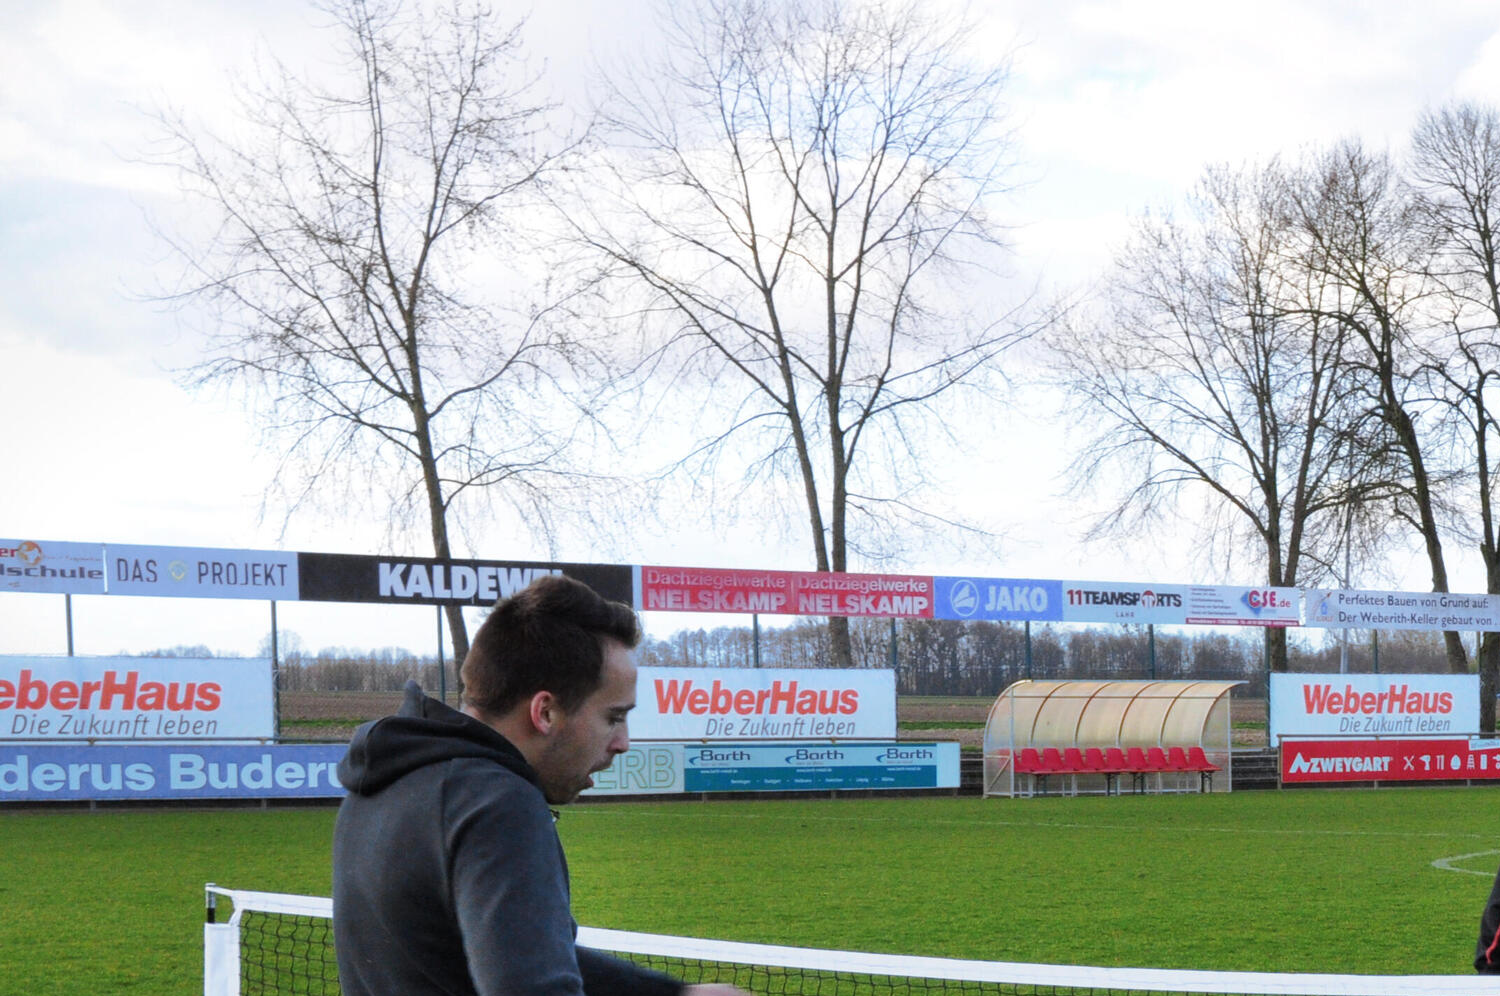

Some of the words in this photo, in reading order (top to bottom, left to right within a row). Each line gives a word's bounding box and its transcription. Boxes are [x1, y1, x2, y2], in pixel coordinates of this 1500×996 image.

[116, 558, 157, 583] DAS
[197, 561, 288, 586] PROJEKT
[378, 562, 564, 600] KALDEW
[647, 570, 786, 589] Dachziegelwerke
[798, 576, 928, 593] Dachziegelwerke
[648, 588, 787, 611] NELSKAMP
[799, 593, 929, 615] NELSKAMP
[985, 586, 1048, 612] JAKO
[1338, 594, 1384, 607] Perfektes
[1388, 595, 1417, 607] Bauen
[1439, 597, 1470, 608] Grund
[1338, 612, 1357, 623] Der
[1360, 613, 1438, 624] Weberith-Keller
[1441, 616, 1473, 628] gebaut
[654, 679, 859, 715] WeberHaus
[1303, 684, 1453, 715] WeberHaus
[11, 714, 51, 735] Die
[57, 714, 150, 738] Zukunft
[156, 714, 218, 735] leben
[705, 718, 734, 736] Die
[739, 717, 806, 738] Zukunft
[809, 718, 856, 736] leben
[1339, 717, 1360, 732] Die
[1363, 716, 1412, 734] Zukunft
[1416, 717, 1451, 732] leben
[700, 750, 750, 761] Barth
[796, 749, 844, 761] Barth
[887, 749, 933, 760] Barth
[1309, 756, 1392, 773] ZWEYGART
